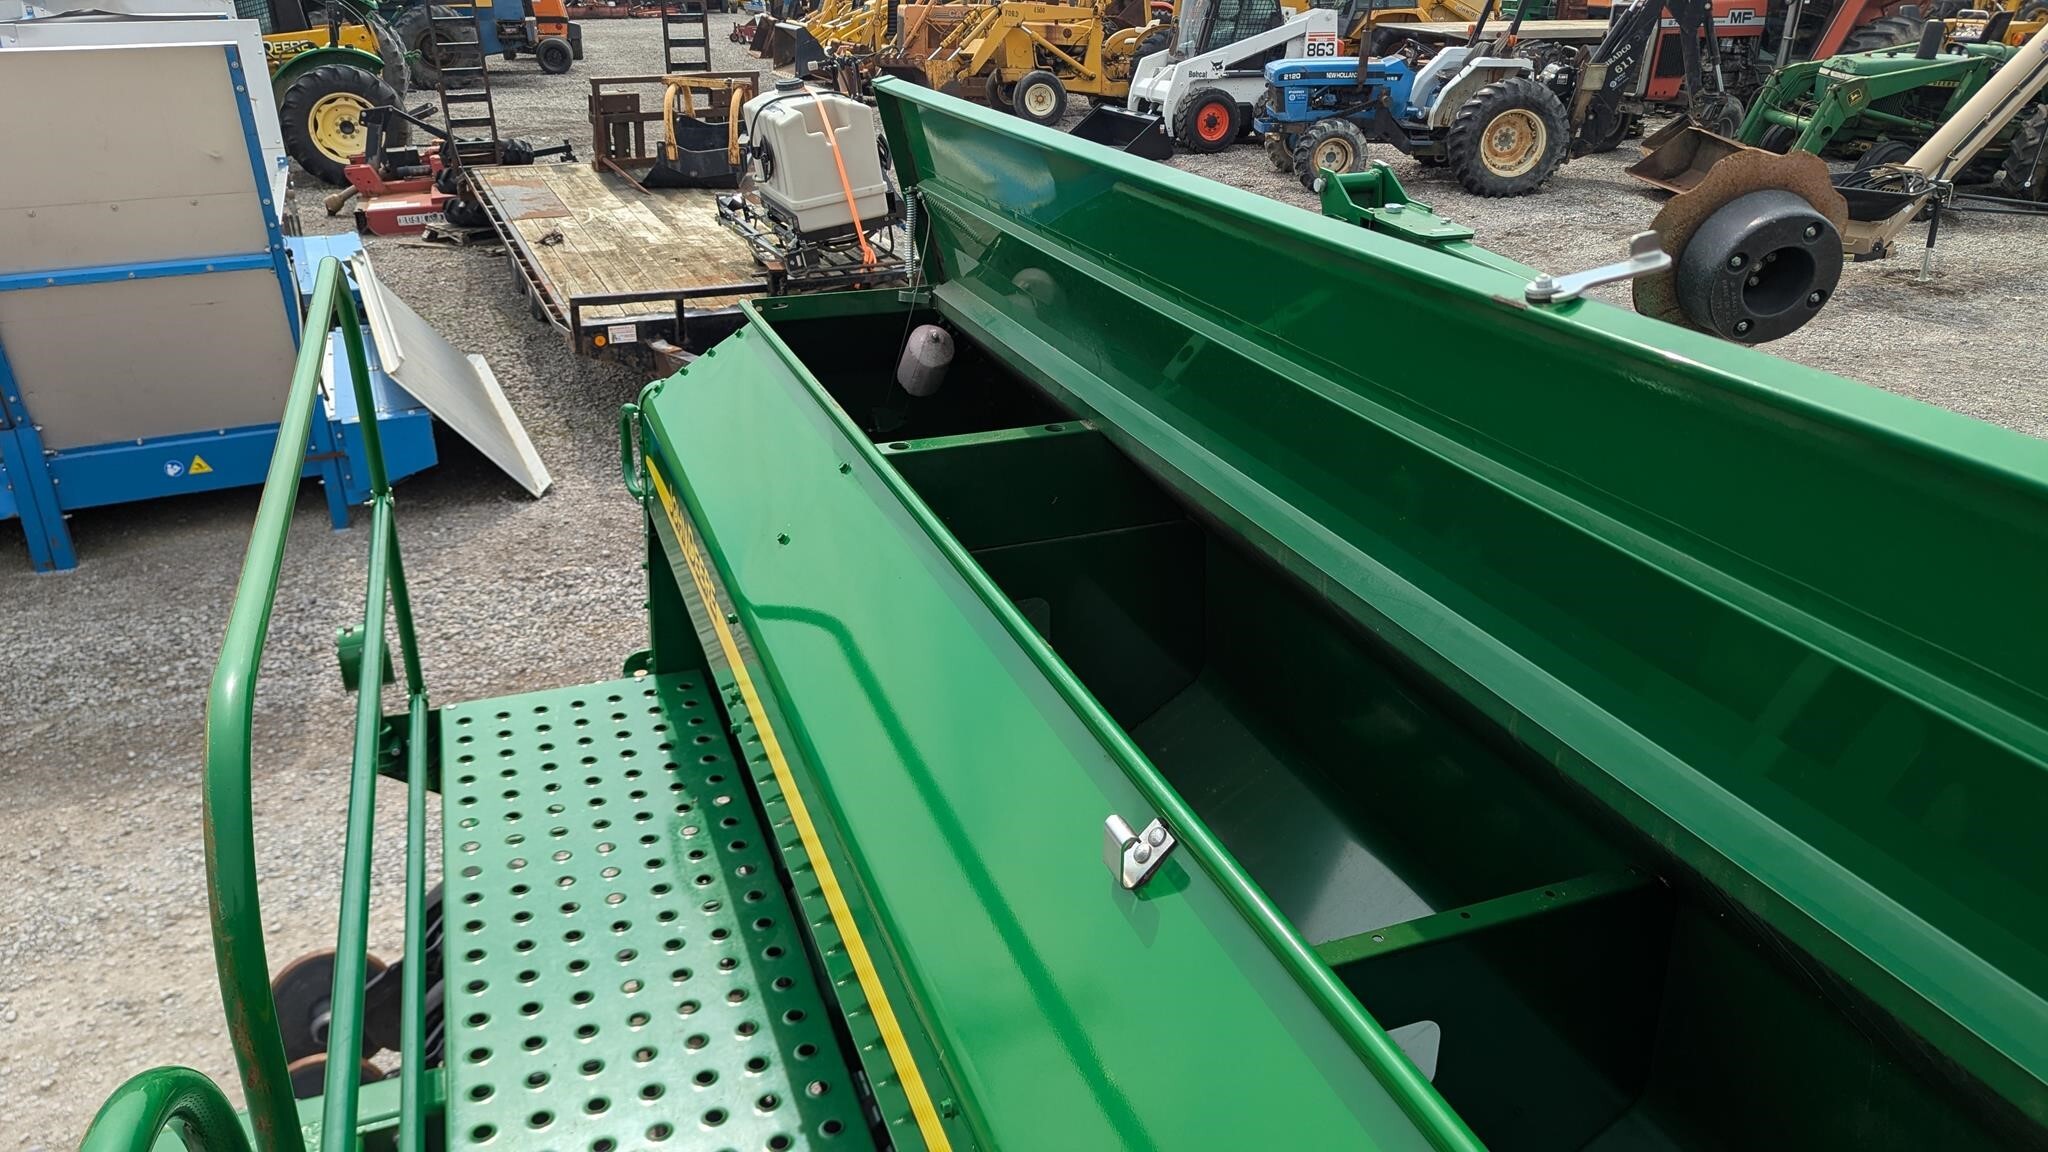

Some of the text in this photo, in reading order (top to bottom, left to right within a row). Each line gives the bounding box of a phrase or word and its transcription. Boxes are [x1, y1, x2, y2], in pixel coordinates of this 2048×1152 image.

[1730, 11, 1753, 24] MF
[1307, 42, 1335, 57] 863
[1614, 56, 1635, 74] 611
[1188, 70, 1208, 78] Bobcat
